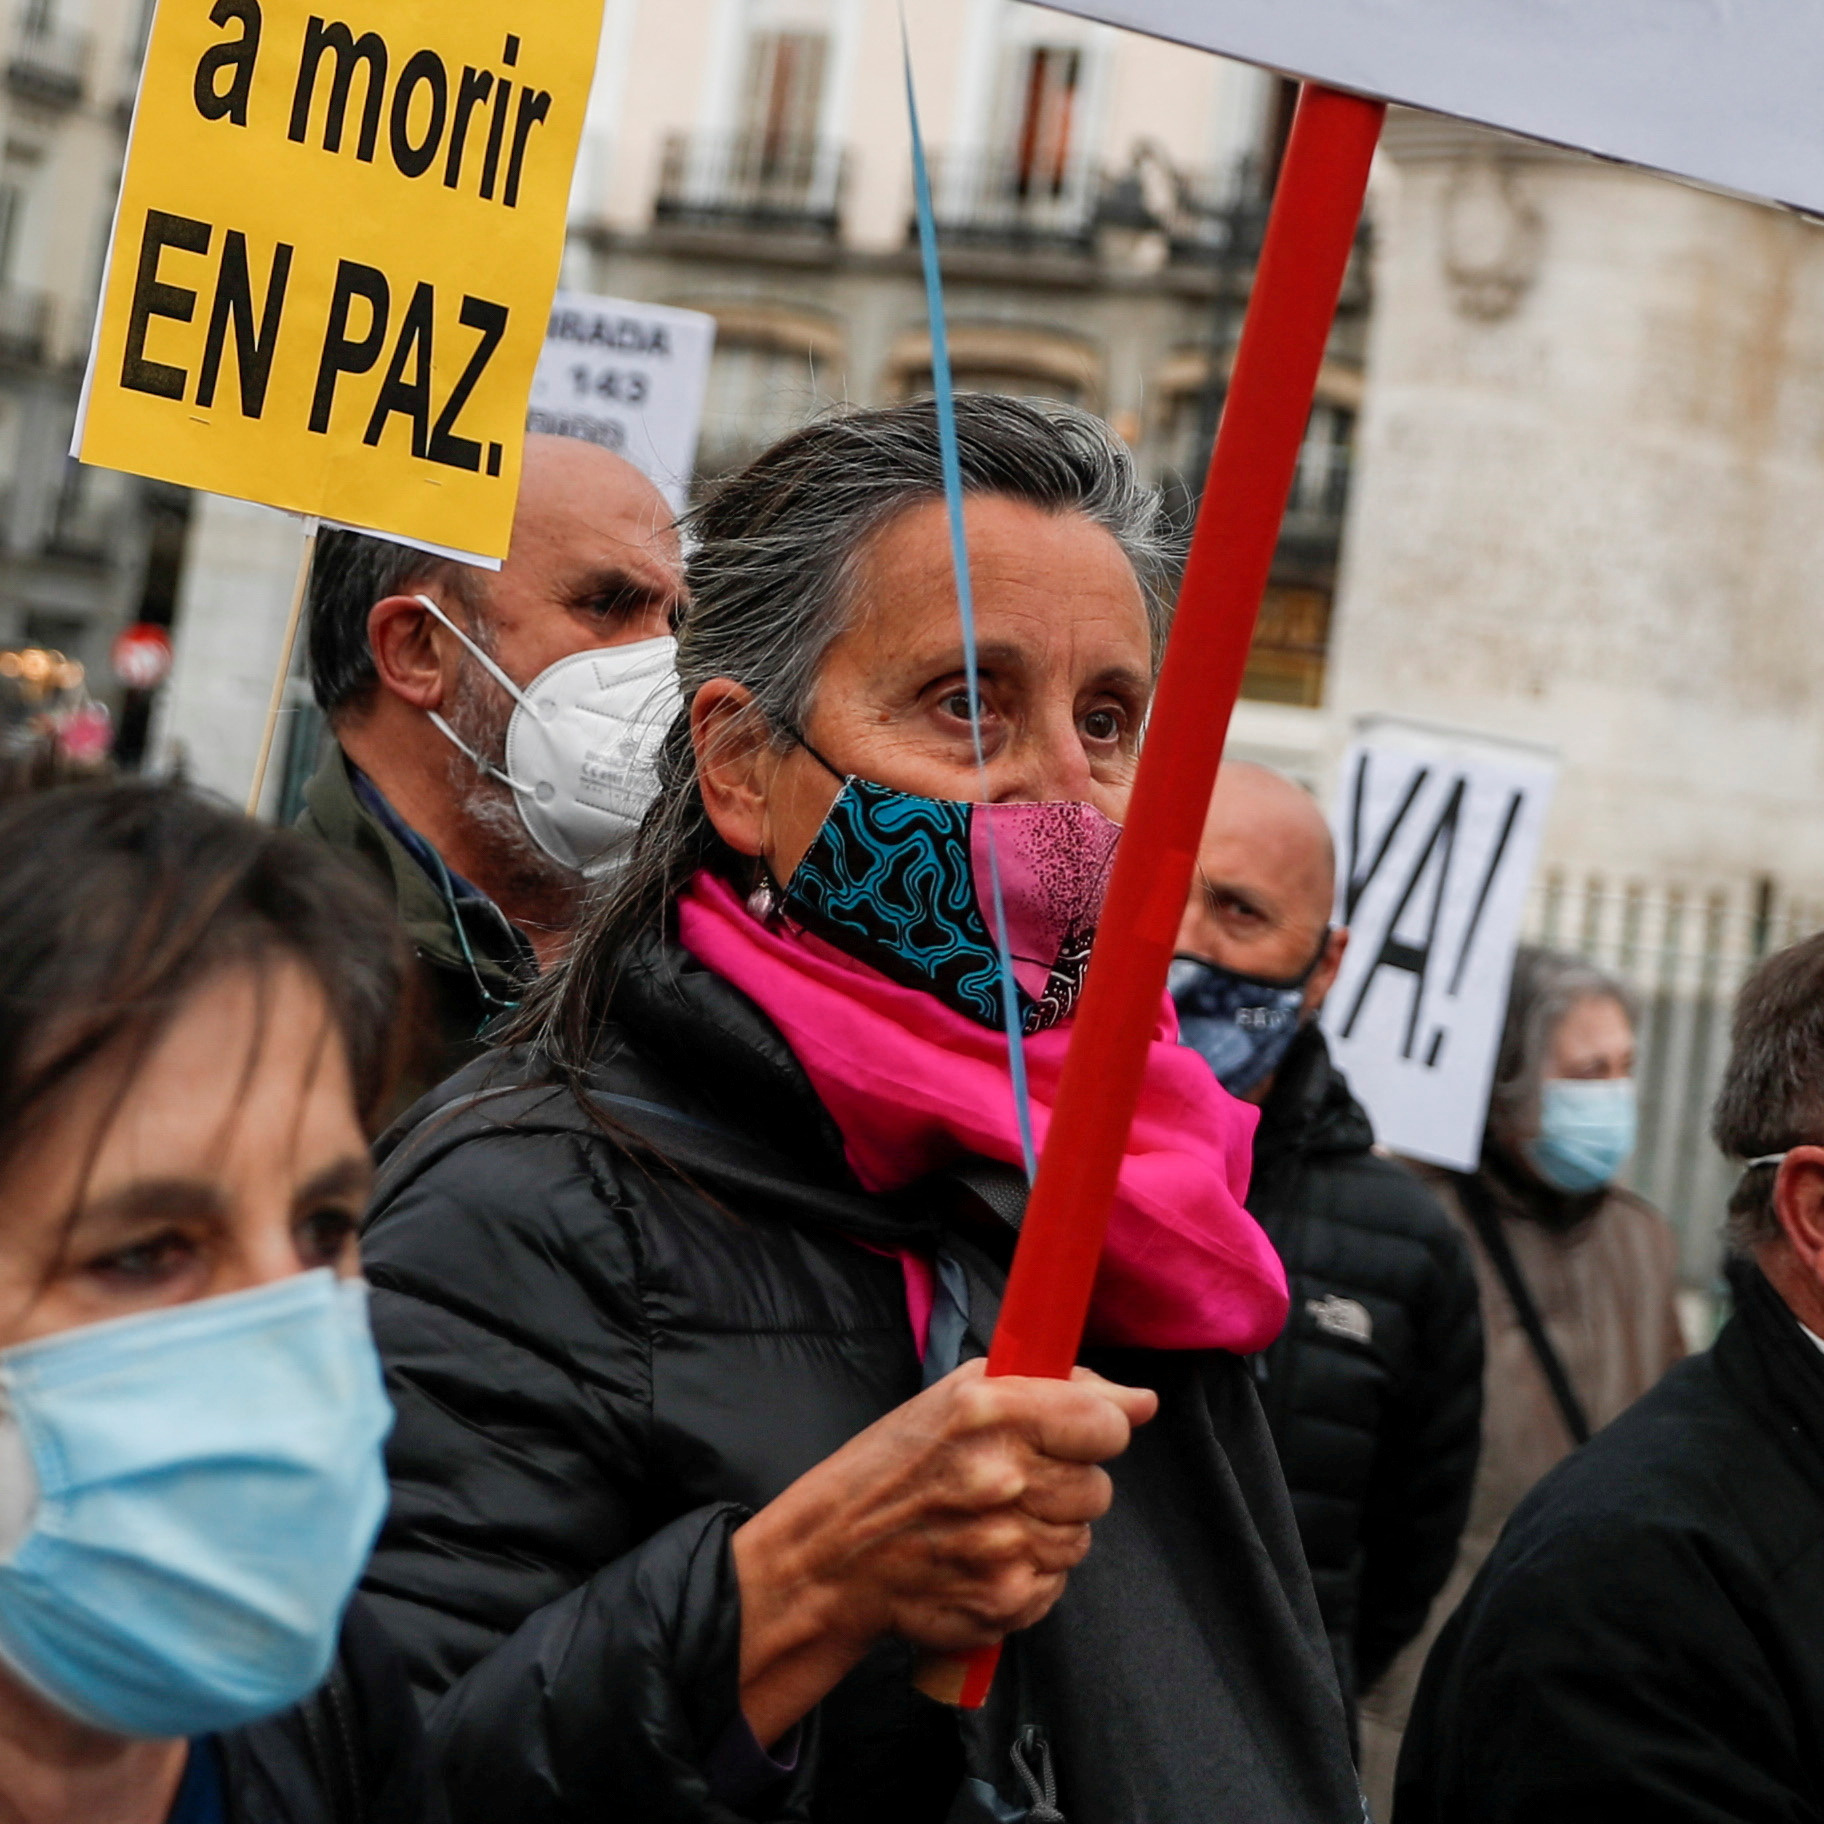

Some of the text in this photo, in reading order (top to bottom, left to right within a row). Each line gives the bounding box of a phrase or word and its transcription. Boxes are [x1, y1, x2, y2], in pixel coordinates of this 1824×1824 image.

[287, 32, 553, 210] morir
[119, 208, 511, 479] EN PAZ.
[570, 363, 649, 405] 143
[1340, 752, 1524, 1069] YA!
